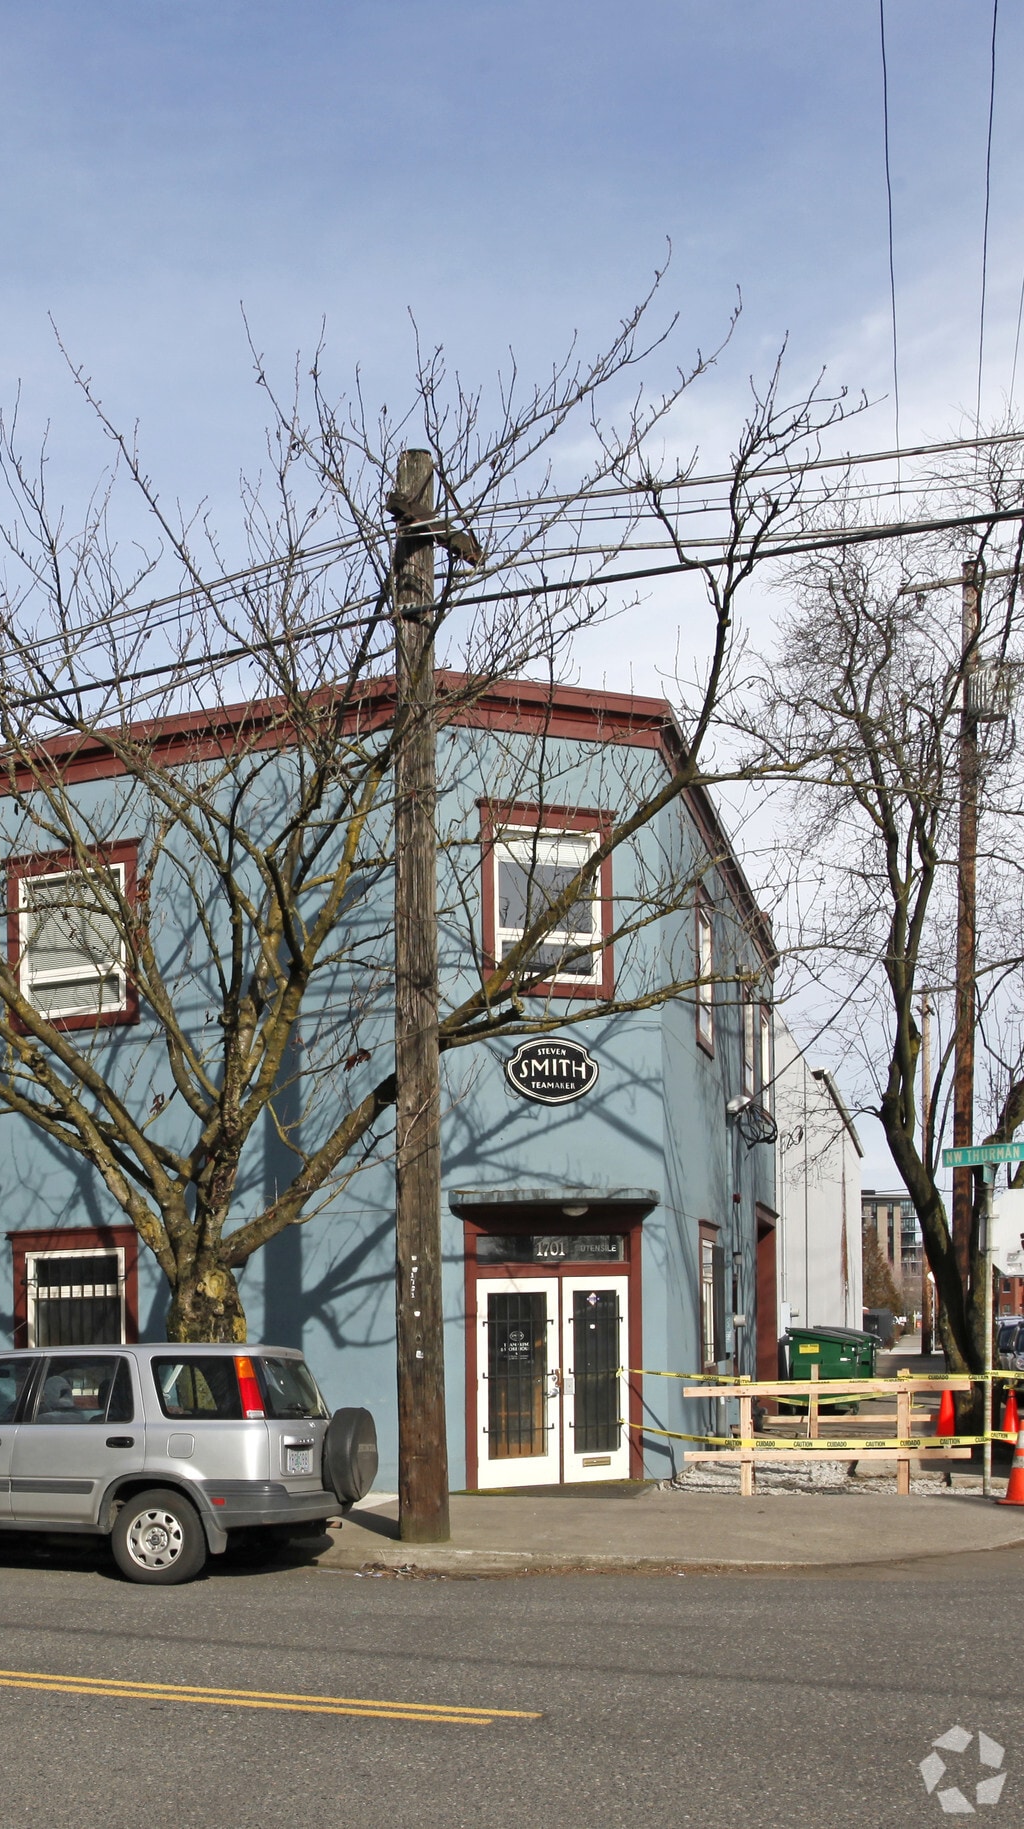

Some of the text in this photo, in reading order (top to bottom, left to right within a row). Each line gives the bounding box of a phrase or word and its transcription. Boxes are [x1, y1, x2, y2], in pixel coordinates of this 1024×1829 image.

[537, 1047, 567, 1056] STEVEN
[519, 1058, 587, 1079] SMITH
[531, 1081, 576, 1090] TEAMAKER
[946, 1146, 1020, 1164] NW THURMAN
[536, 1241, 566, 1257] 1701
